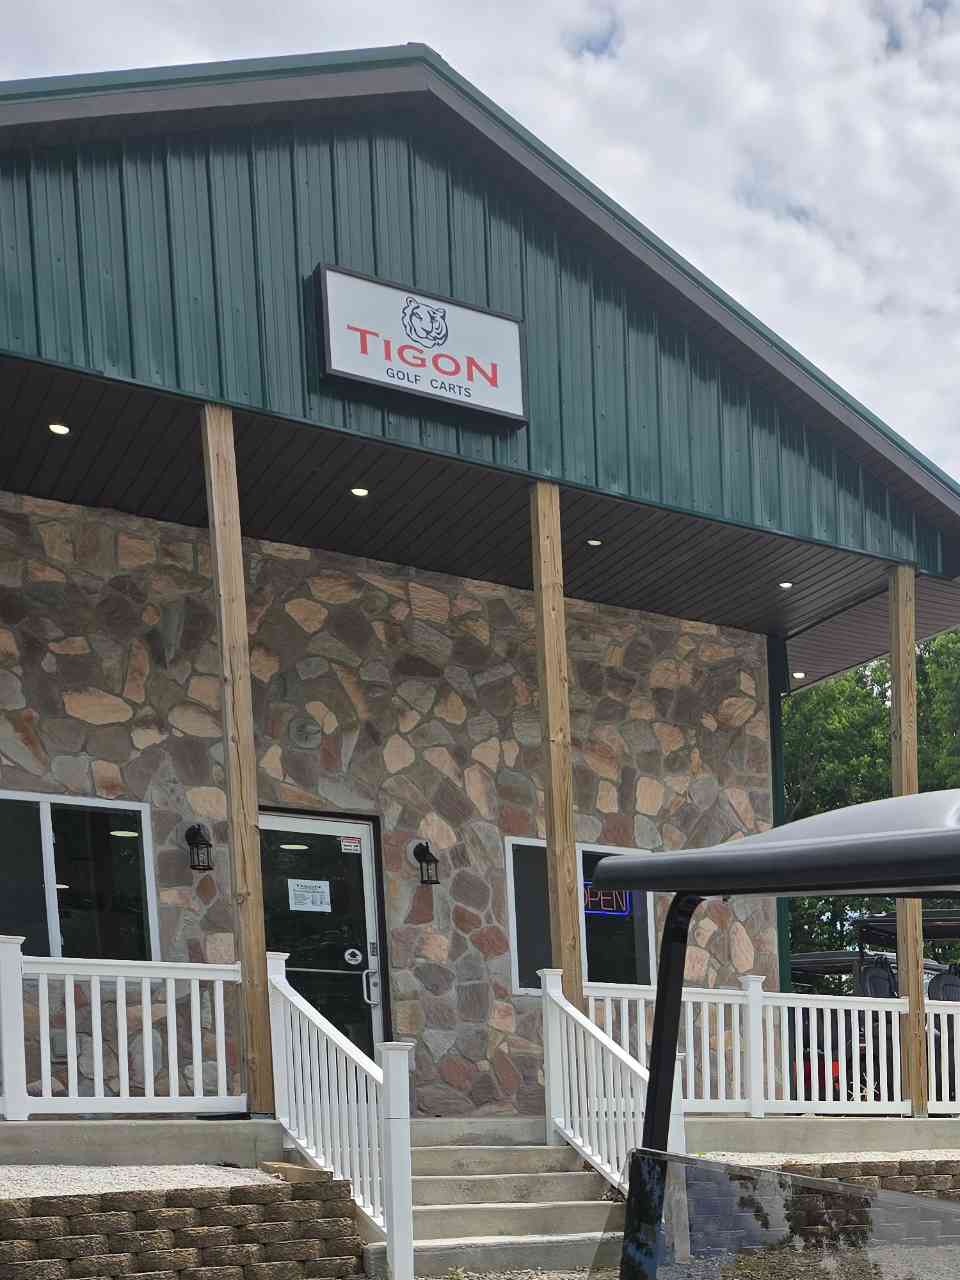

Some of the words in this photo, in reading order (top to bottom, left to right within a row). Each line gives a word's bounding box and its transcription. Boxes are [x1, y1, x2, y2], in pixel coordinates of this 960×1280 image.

[346, 323, 499, 388] TIGON
[386, 368, 421, 385] GOLF
[430, 379, 472, 398] CARTS
